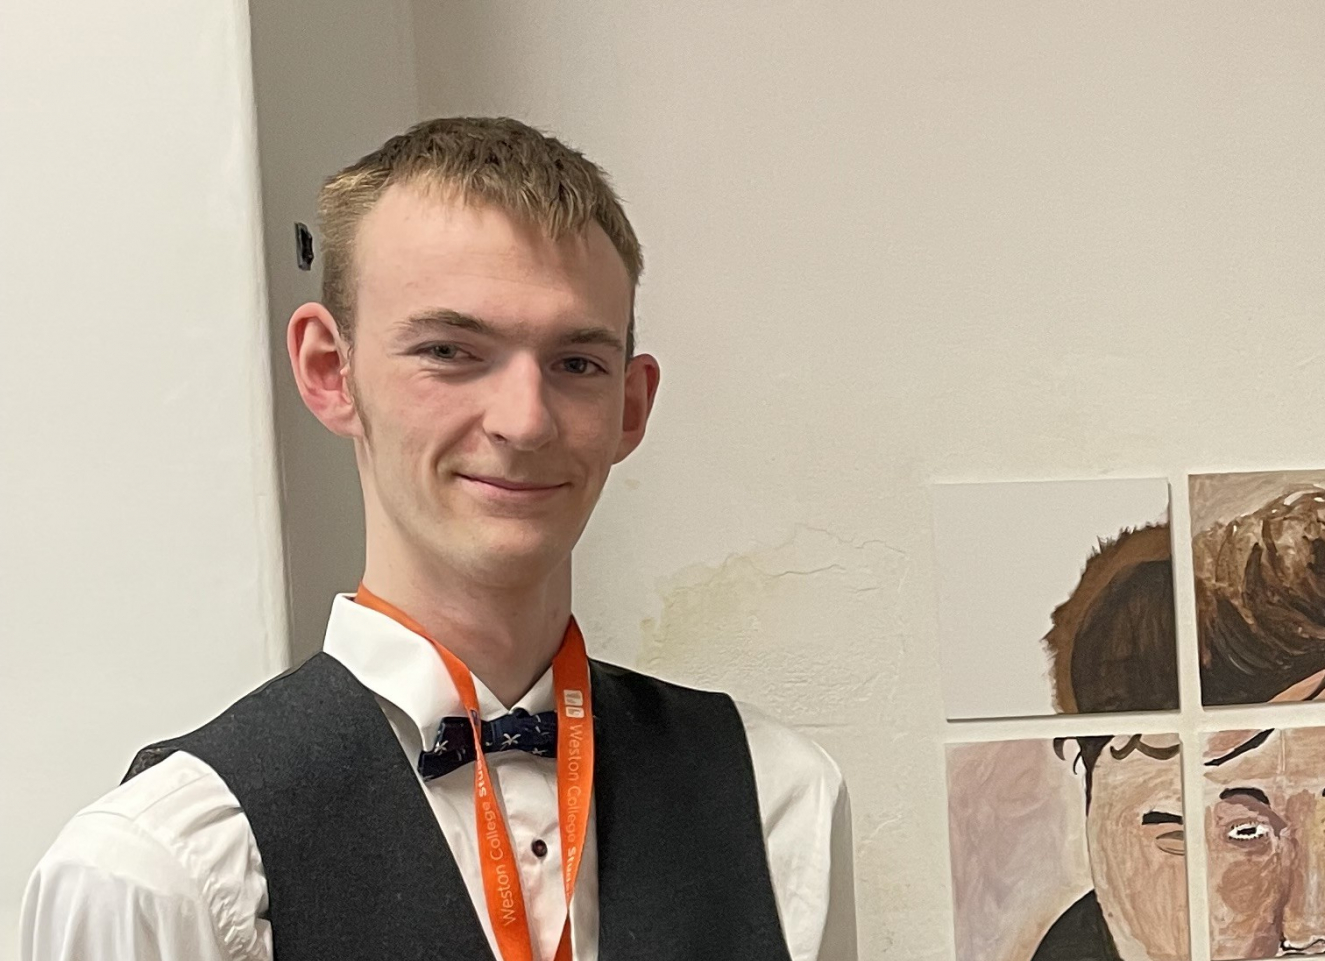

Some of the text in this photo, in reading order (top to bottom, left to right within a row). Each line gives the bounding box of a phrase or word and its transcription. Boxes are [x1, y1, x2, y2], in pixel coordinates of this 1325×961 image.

[568, 723, 584, 782] Weston
[483, 801, 504, 860] College
[565, 784, 582, 843] College
[497, 864, 516, 927] Weston
